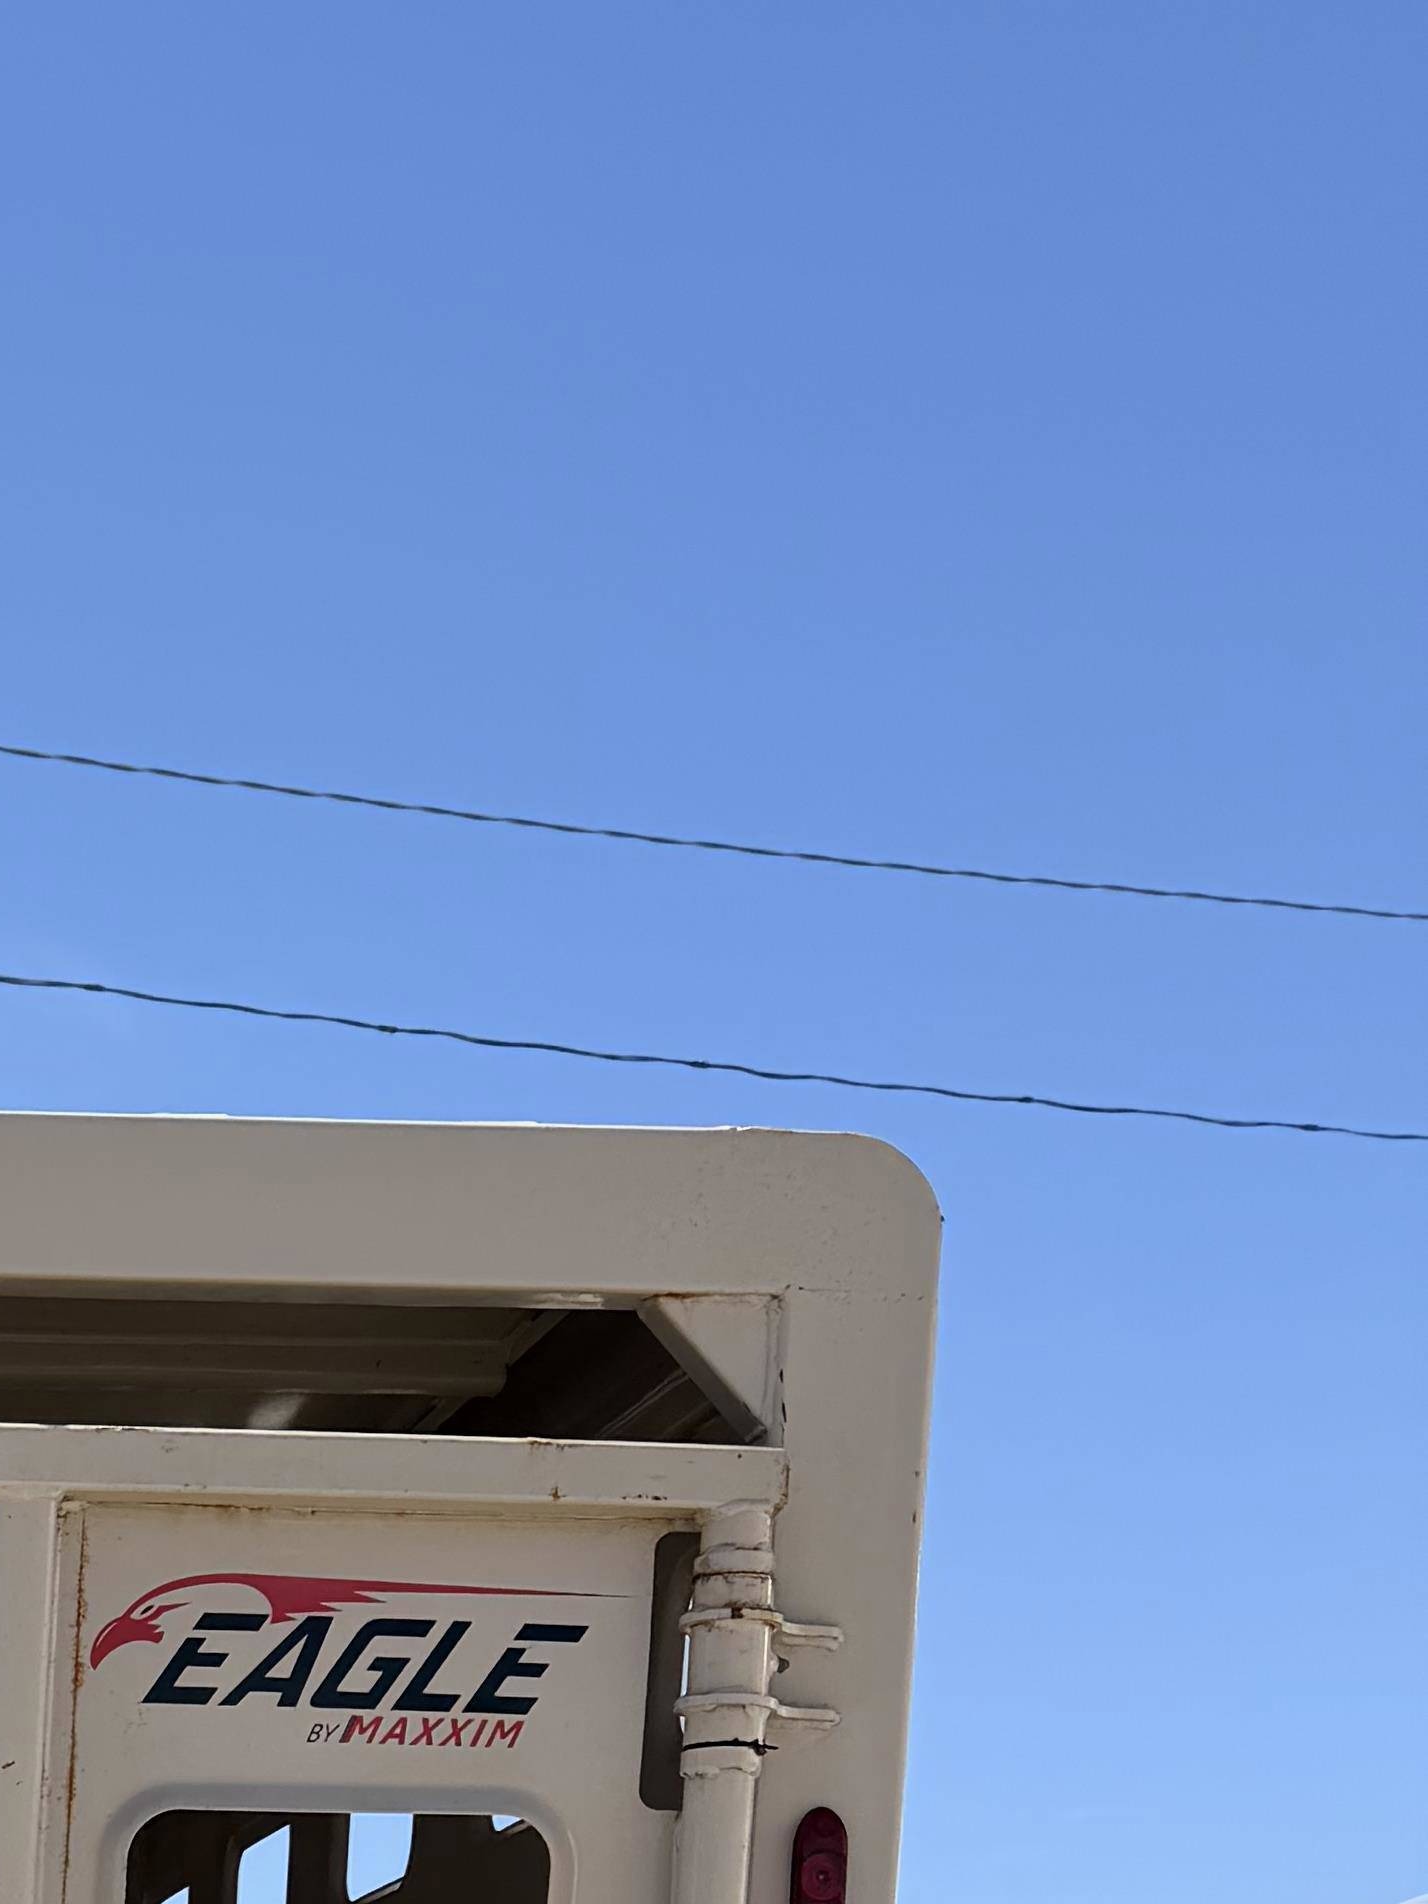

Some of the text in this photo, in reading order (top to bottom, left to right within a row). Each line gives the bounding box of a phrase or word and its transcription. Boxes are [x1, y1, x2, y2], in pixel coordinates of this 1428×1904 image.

[140, 1612, 590, 1715] EAGLE
[306, 1714, 525, 1749] BY MAXXIM
